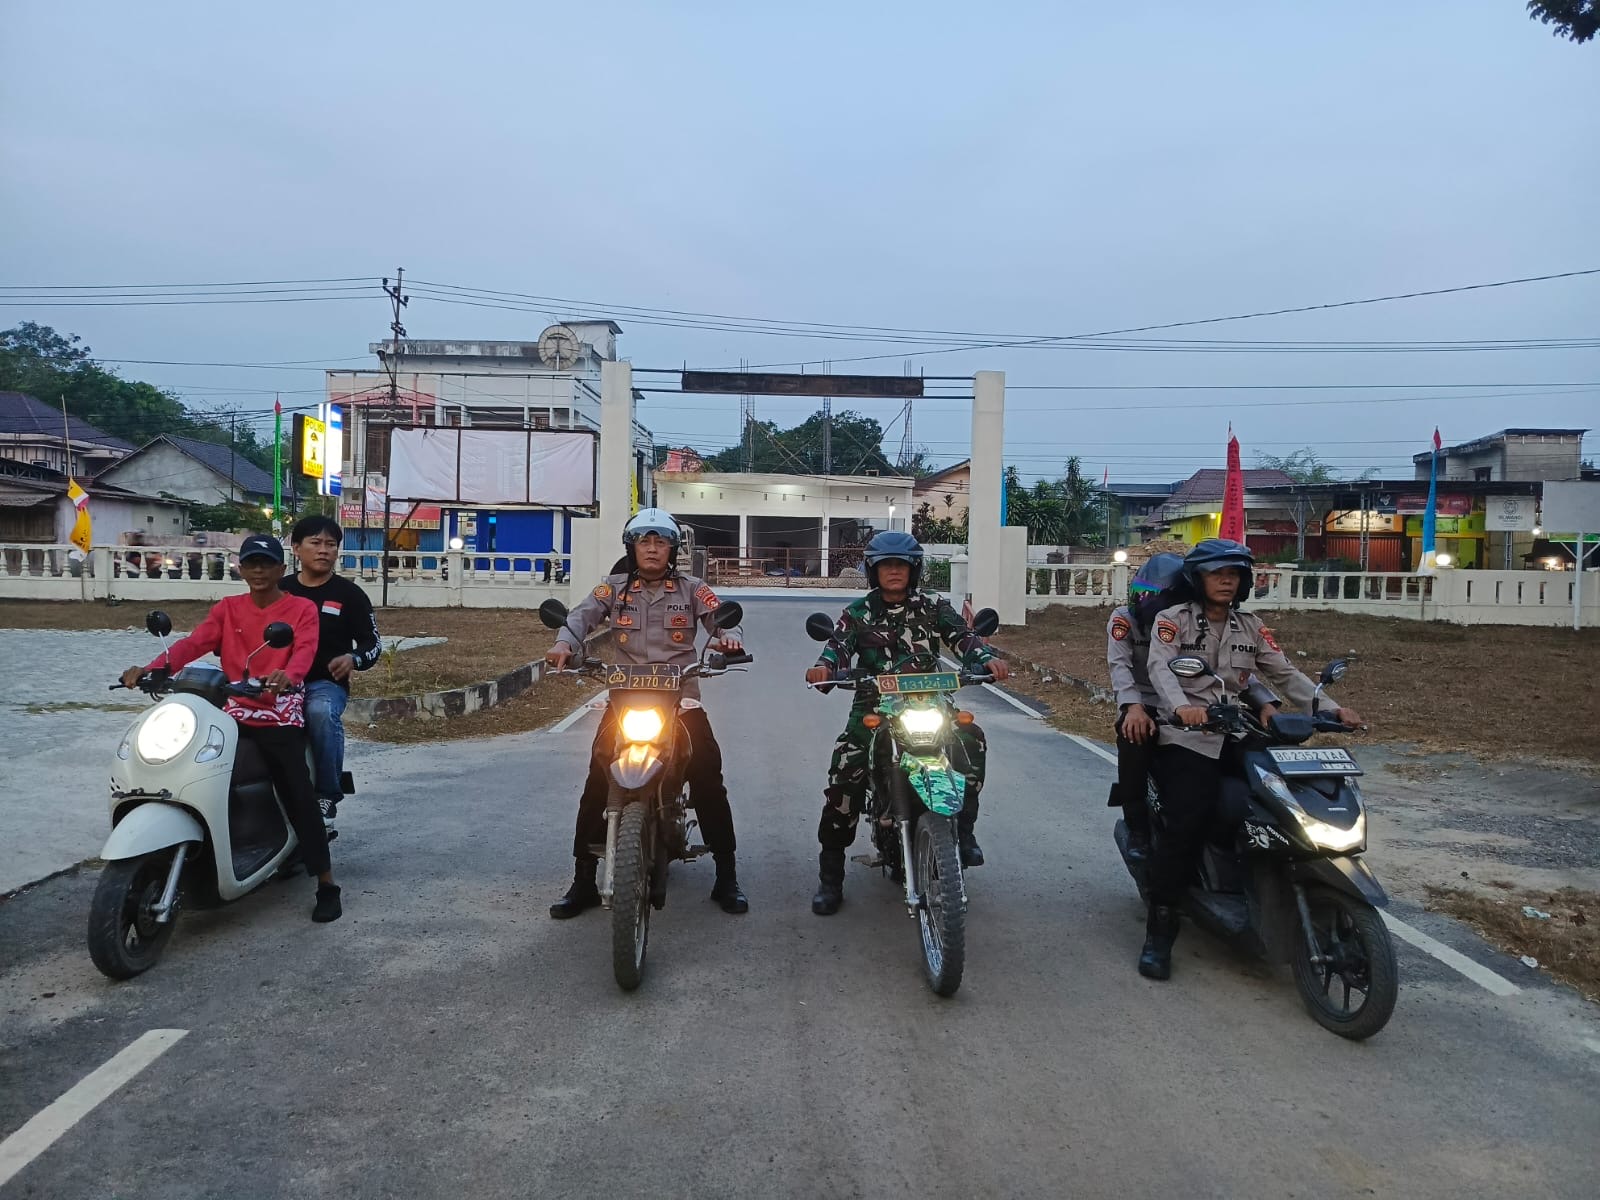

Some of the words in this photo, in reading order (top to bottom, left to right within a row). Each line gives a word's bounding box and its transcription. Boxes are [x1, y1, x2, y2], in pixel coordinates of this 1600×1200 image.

[305, 418, 325, 433] POLISI
[652, 665, 658, 675] V
[632, 676, 659, 687] 2170
[664, 676, 676, 689] 41
[1291, 751, 1320, 761] 2352
[1266, 825, 1290, 846] HONDA
